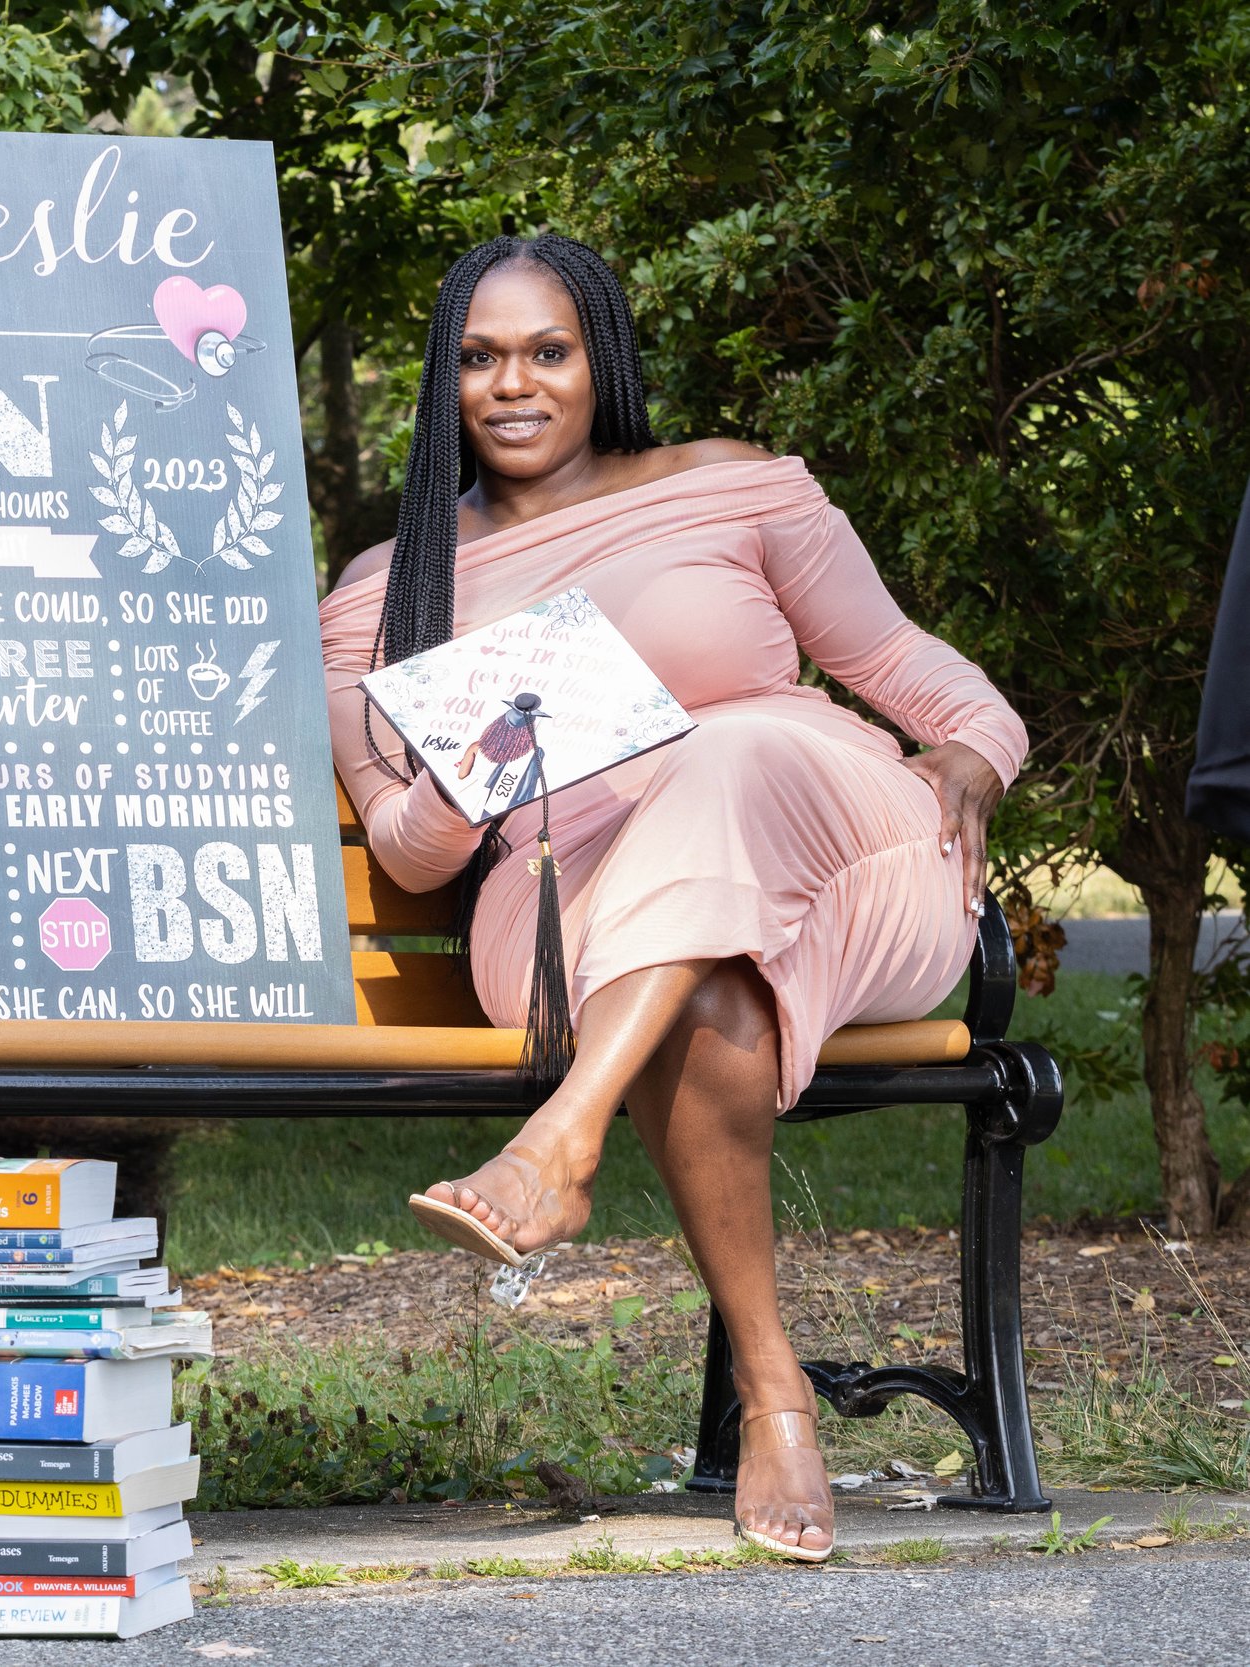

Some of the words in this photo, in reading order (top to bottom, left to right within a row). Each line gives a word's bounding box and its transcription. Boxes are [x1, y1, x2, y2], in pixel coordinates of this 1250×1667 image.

[143, 457, 228, 492] 2023
[15, 591, 109, 628] COULD,
[119, 591, 154, 625] SO
[168, 593, 213, 625] SHE
[225, 594, 269, 626] DID
[491, 621, 535, 643] God
[134, 645, 180, 673] LOTS
[526, 647, 557, 667] IN
[137, 678, 164, 705] OF
[468, 668, 500, 694] for
[506, 671, 551, 697] you
[139, 710, 213, 737] COFFEE
[75, 764, 113, 790] OF
[135, 763, 292, 791] STUDYING
[495, 772, 519, 799] 2023
[7, 794, 102, 828] EARLY
[116, 794, 295, 828] MORNINGS
[26, 847, 119, 894] NEXT
[125, 841, 323, 966] BSN
[43, 920, 107, 948] STOP
[58, 986, 126, 1021] CAN,
[137, 983, 175, 1019] SO
[187, 983, 241, 1019] SHE
[250, 983, 314, 1018] WILL
[22, 1192, 38, 1206] 6
[58, 1314, 64, 1323] 1
[9, 1376, 19, 1426] PAPADAKIS
[21, 1383, 31, 1419] McPHEE
[34, 1385, 43, 1419] RABOW
[39, 1460, 71, 1470] Temesgen
[0, 1489, 98, 1512] DUMMIES
[48, 1555, 79, 1565] Temesgen
[33, 1583, 72, 1592] DWAYNE
[73, 1583, 82, 1592] A.
[83, 1584, 127, 1592] WILLIAMS
[11, 1609, 67, 1622] REVIEW
